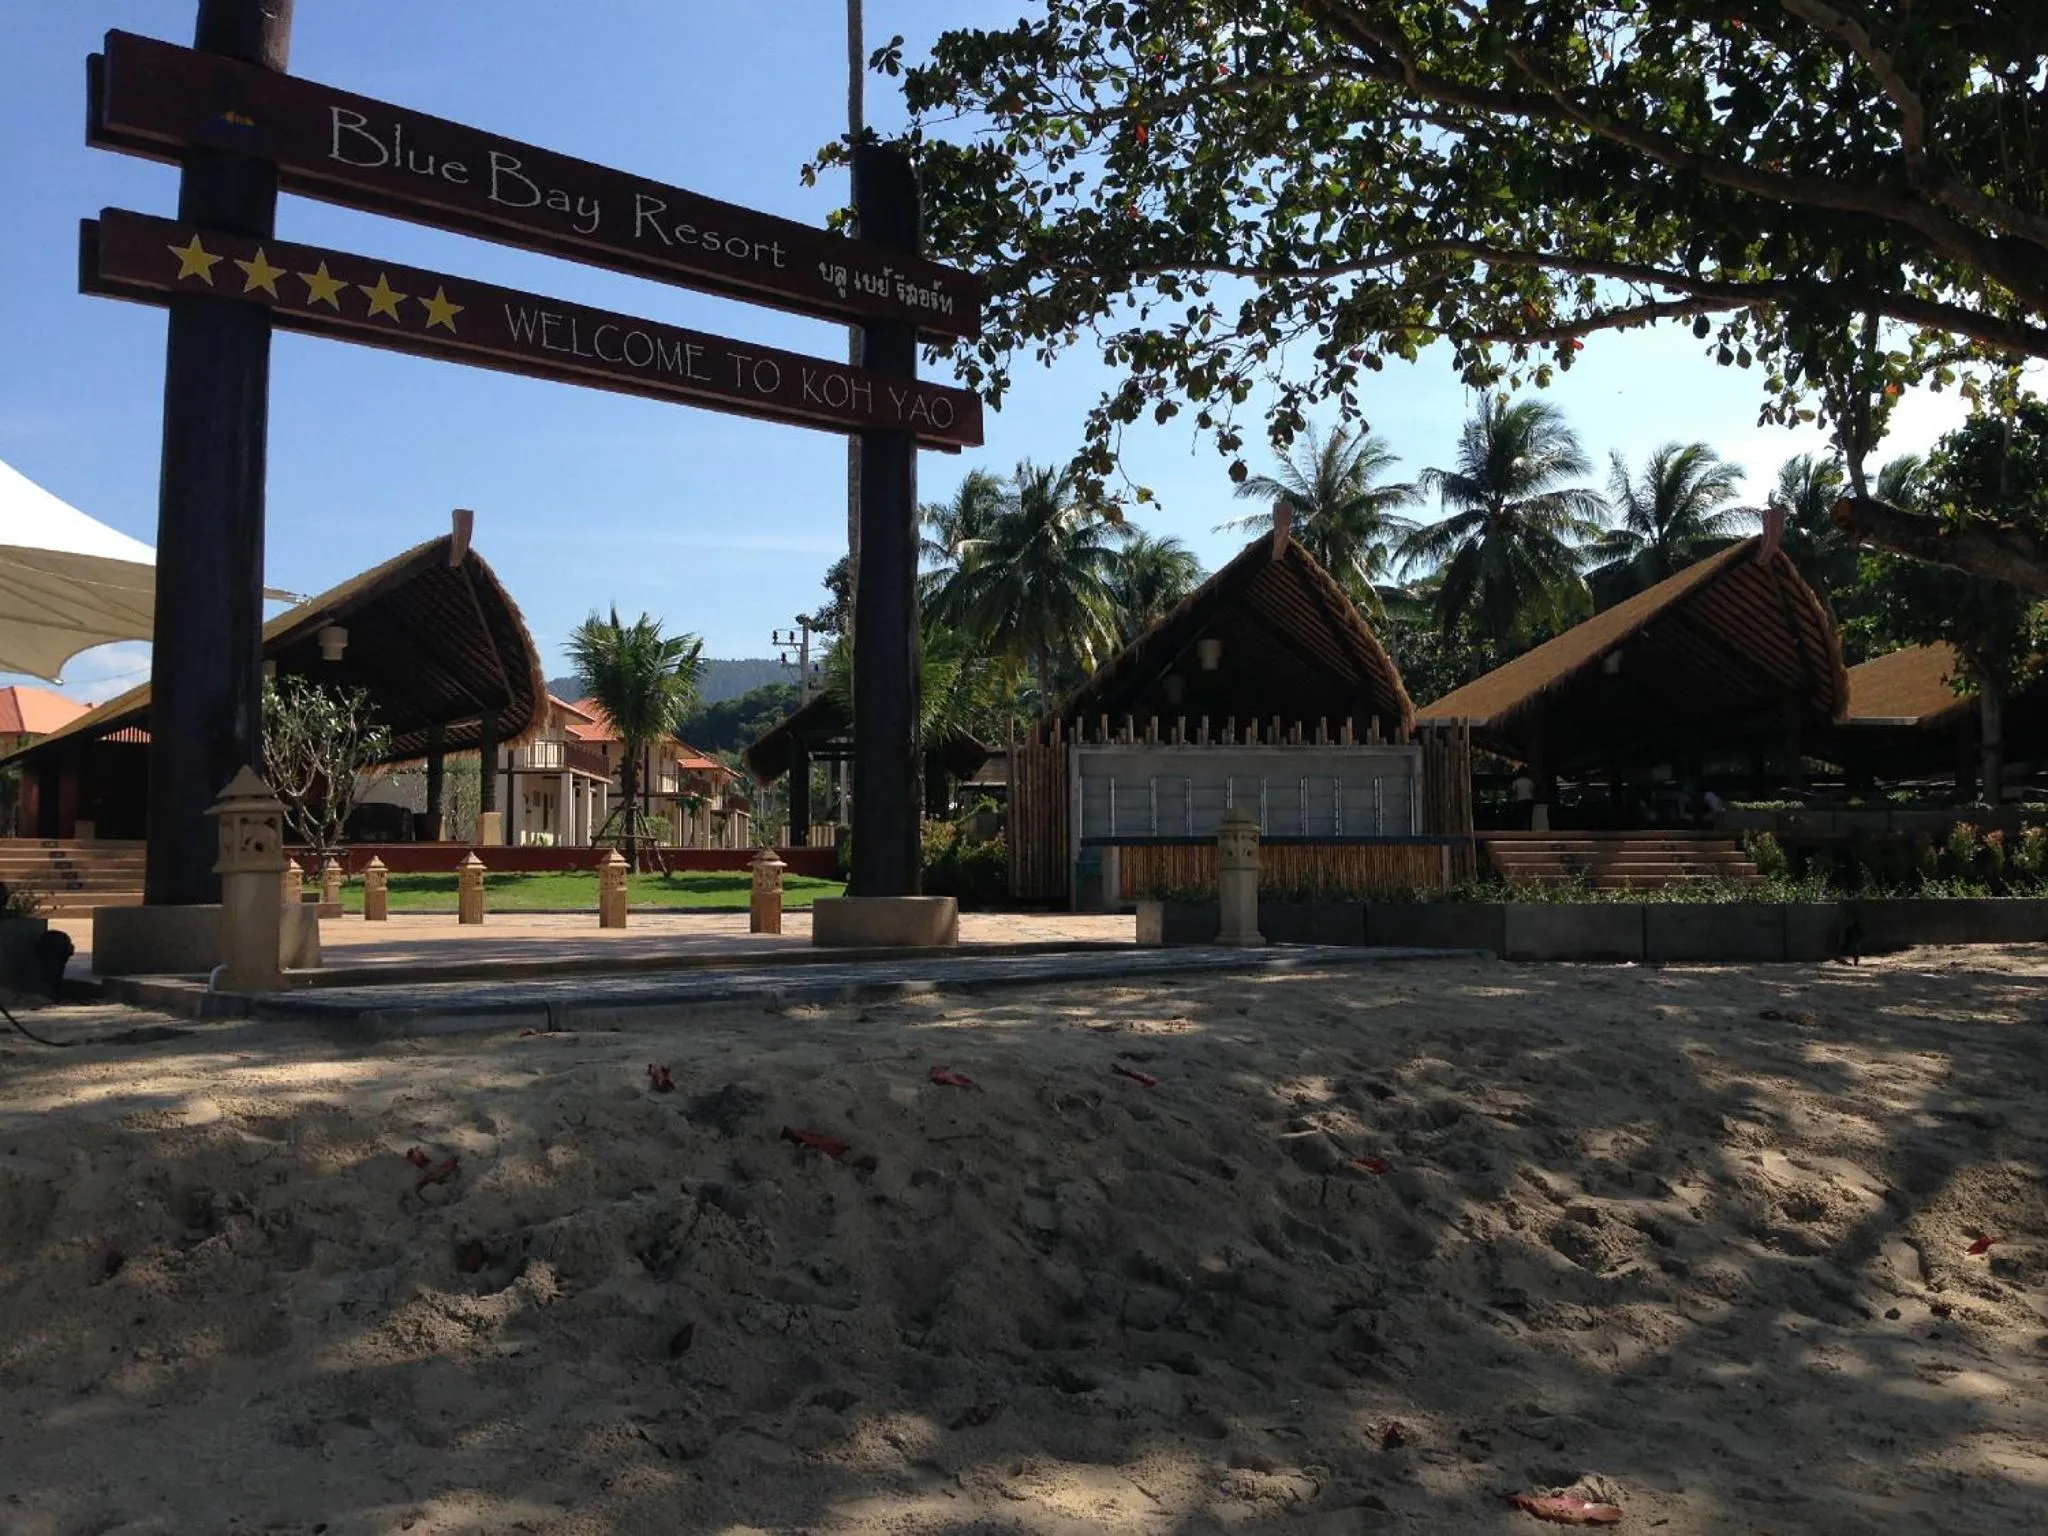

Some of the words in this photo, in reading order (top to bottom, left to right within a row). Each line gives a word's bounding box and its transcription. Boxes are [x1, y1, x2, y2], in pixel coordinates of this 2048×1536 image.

[328, 105, 470, 184] Blue
[488, 150, 601, 234] Bay
[634, 193, 786, 268] Resort
[503, 303, 712, 382] WELCOME
[726, 350, 782, 393] TO
[801, 366, 873, 413] KOH
[888, 385, 955, 429] YAO
